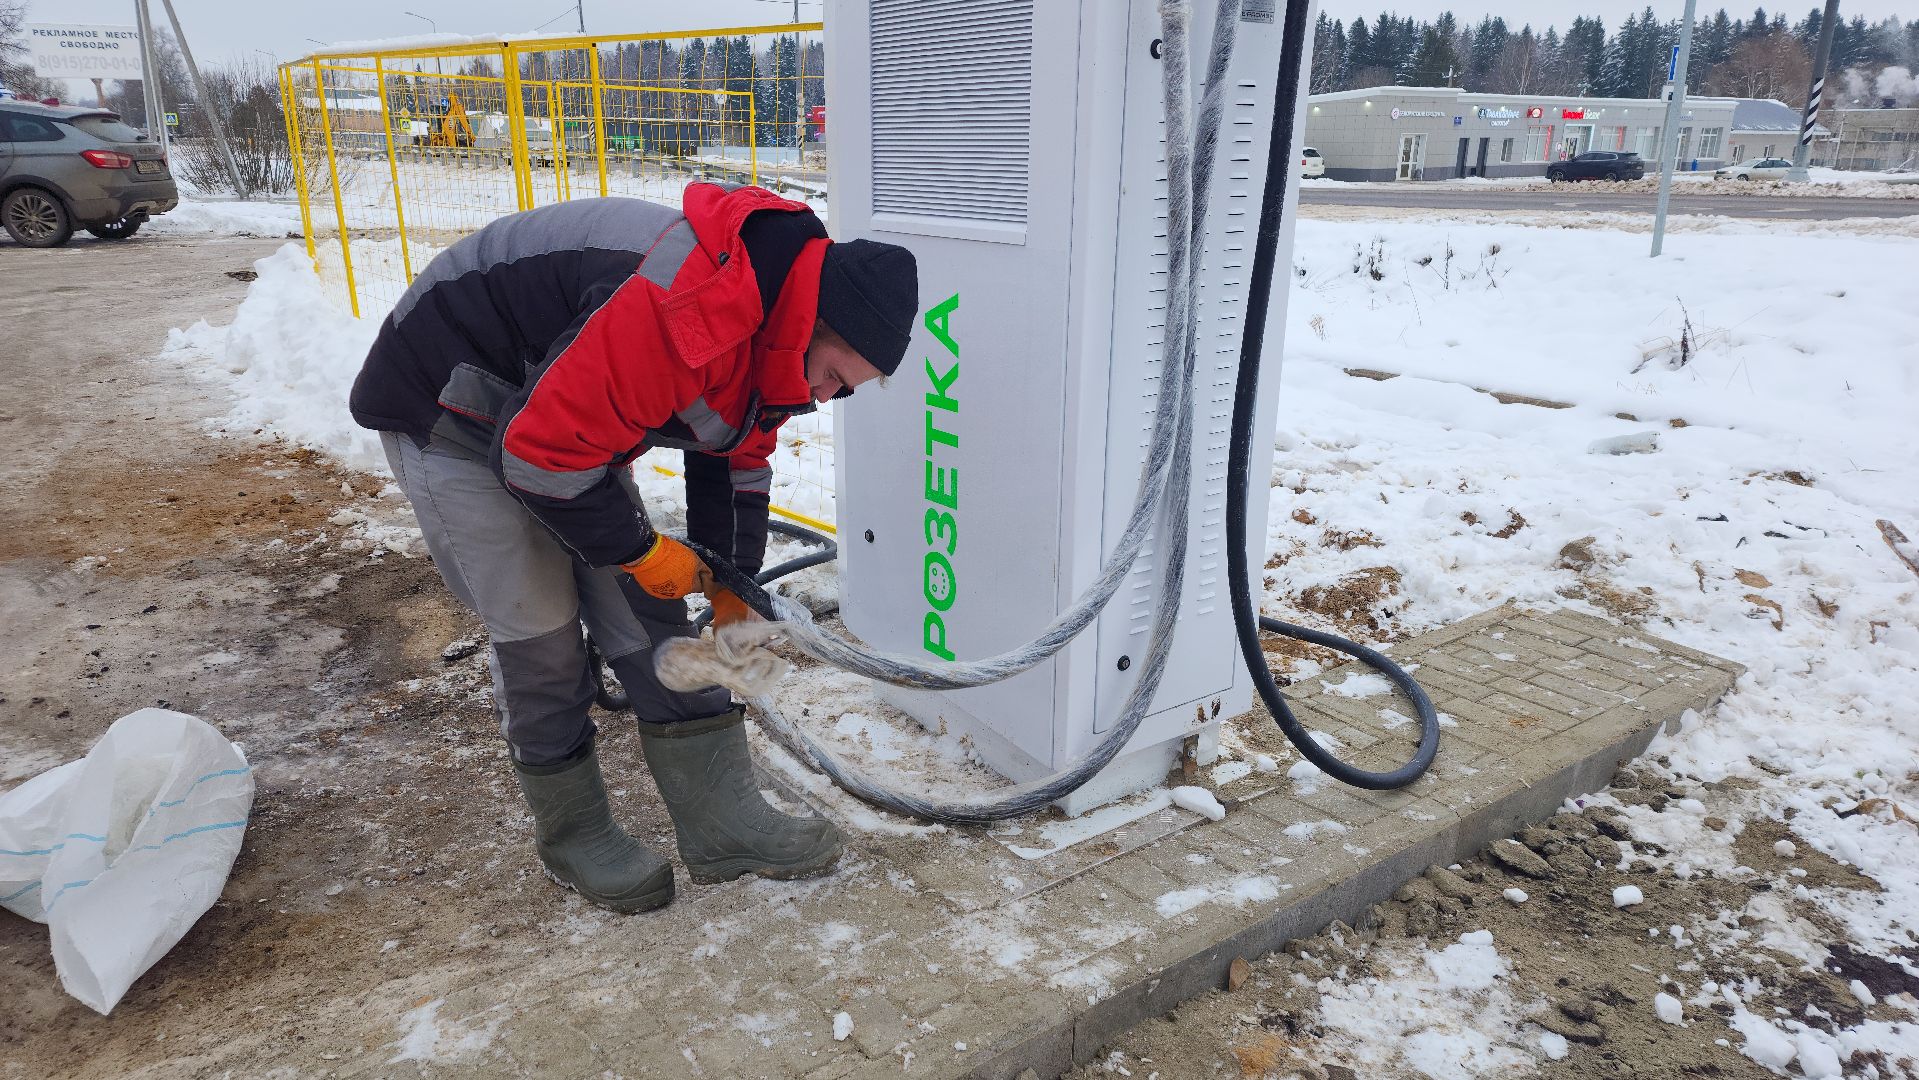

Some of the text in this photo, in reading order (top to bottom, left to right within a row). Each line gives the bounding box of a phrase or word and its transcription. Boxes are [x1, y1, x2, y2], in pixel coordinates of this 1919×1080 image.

[33, 29, 98, 38] РЕКЛАМНОЕ
[60, 41, 119, 49] СВОБОДНО
[38, 55, 140, 71] 8(915)270-01-0
[923, 292, 959, 662] РОЗЕТКА
